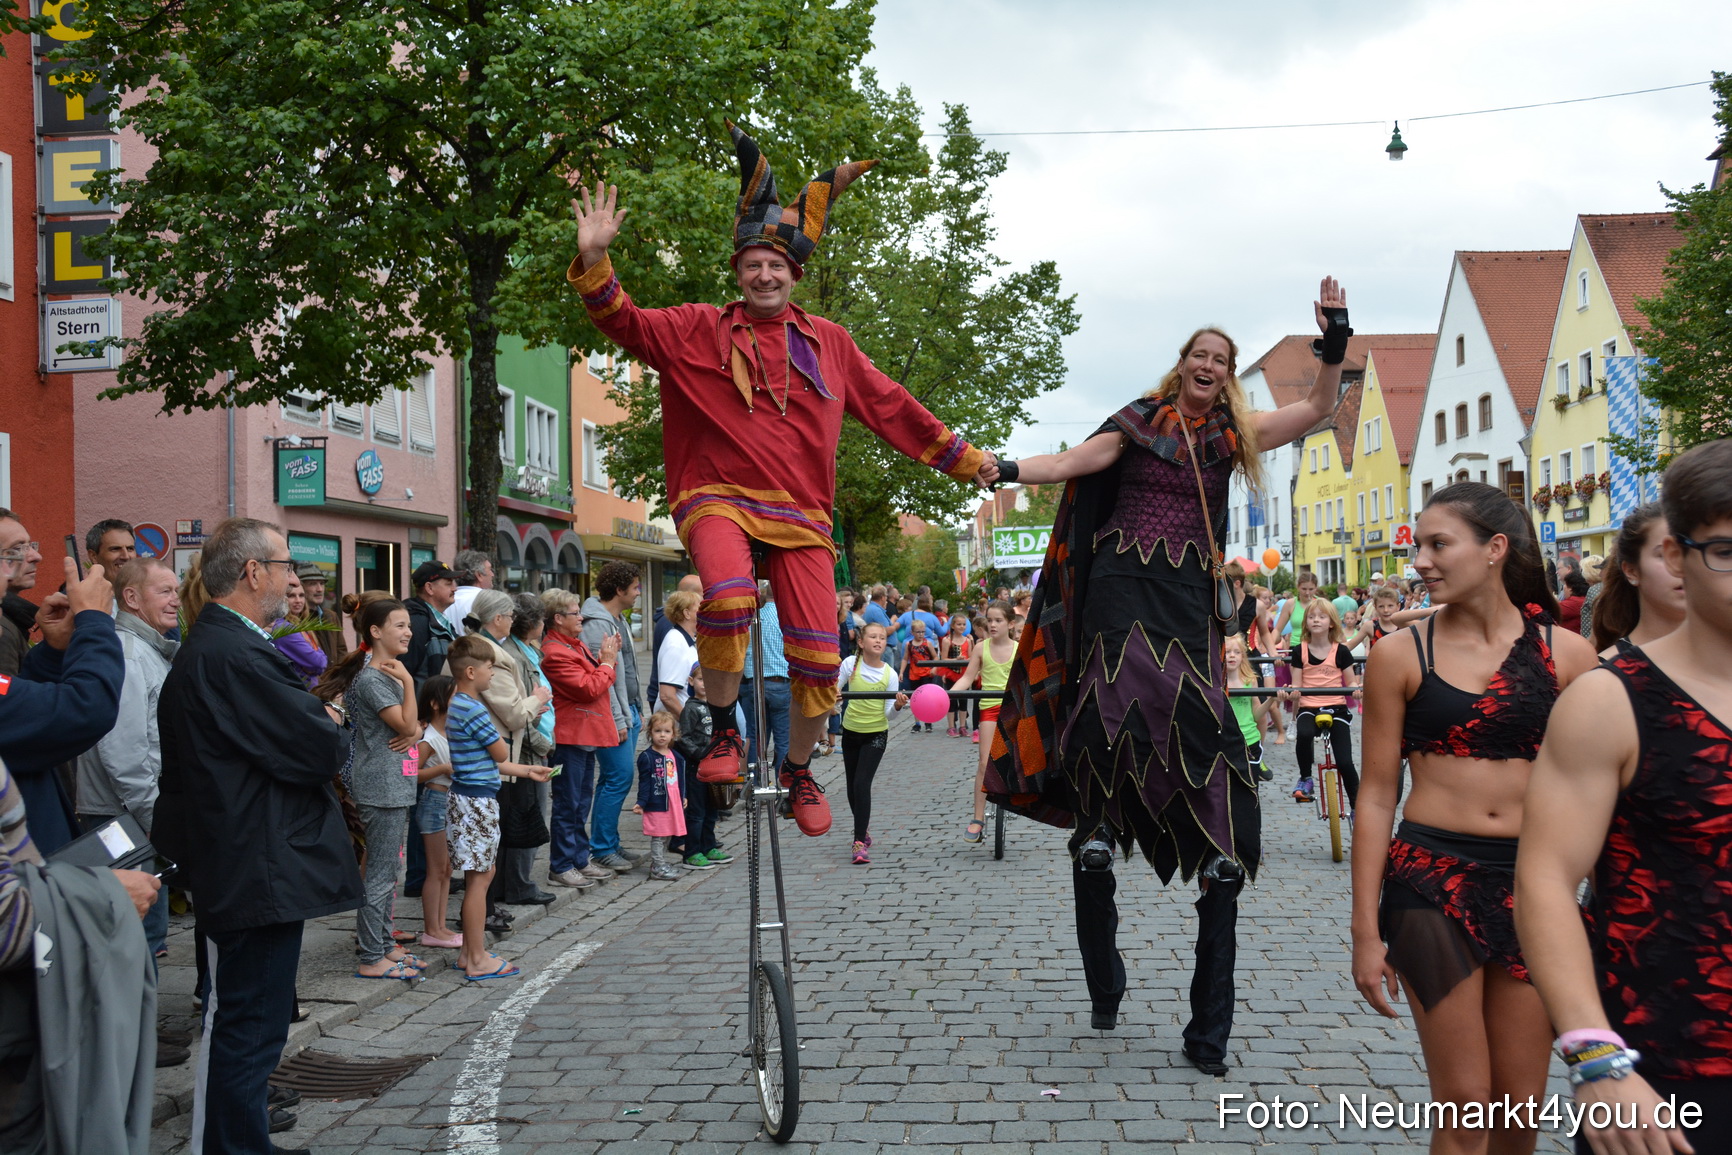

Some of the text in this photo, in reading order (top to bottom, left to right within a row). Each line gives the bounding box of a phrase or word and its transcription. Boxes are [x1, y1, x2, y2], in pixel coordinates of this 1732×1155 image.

[50, 304, 108, 316] Altstadthotel
[57, 321, 100, 336] Stern
[284, 458, 303, 470] vom
[291, 461, 318, 479] FASS
[356, 455, 371, 471] vom
[361, 464, 384, 490] FASS
[1543, 524, 1552, 541] P
[1018, 531, 1054, 552] DA
[319, 544, 337, 560] Whisky
[995, 558, 1018, 566] Sektion
